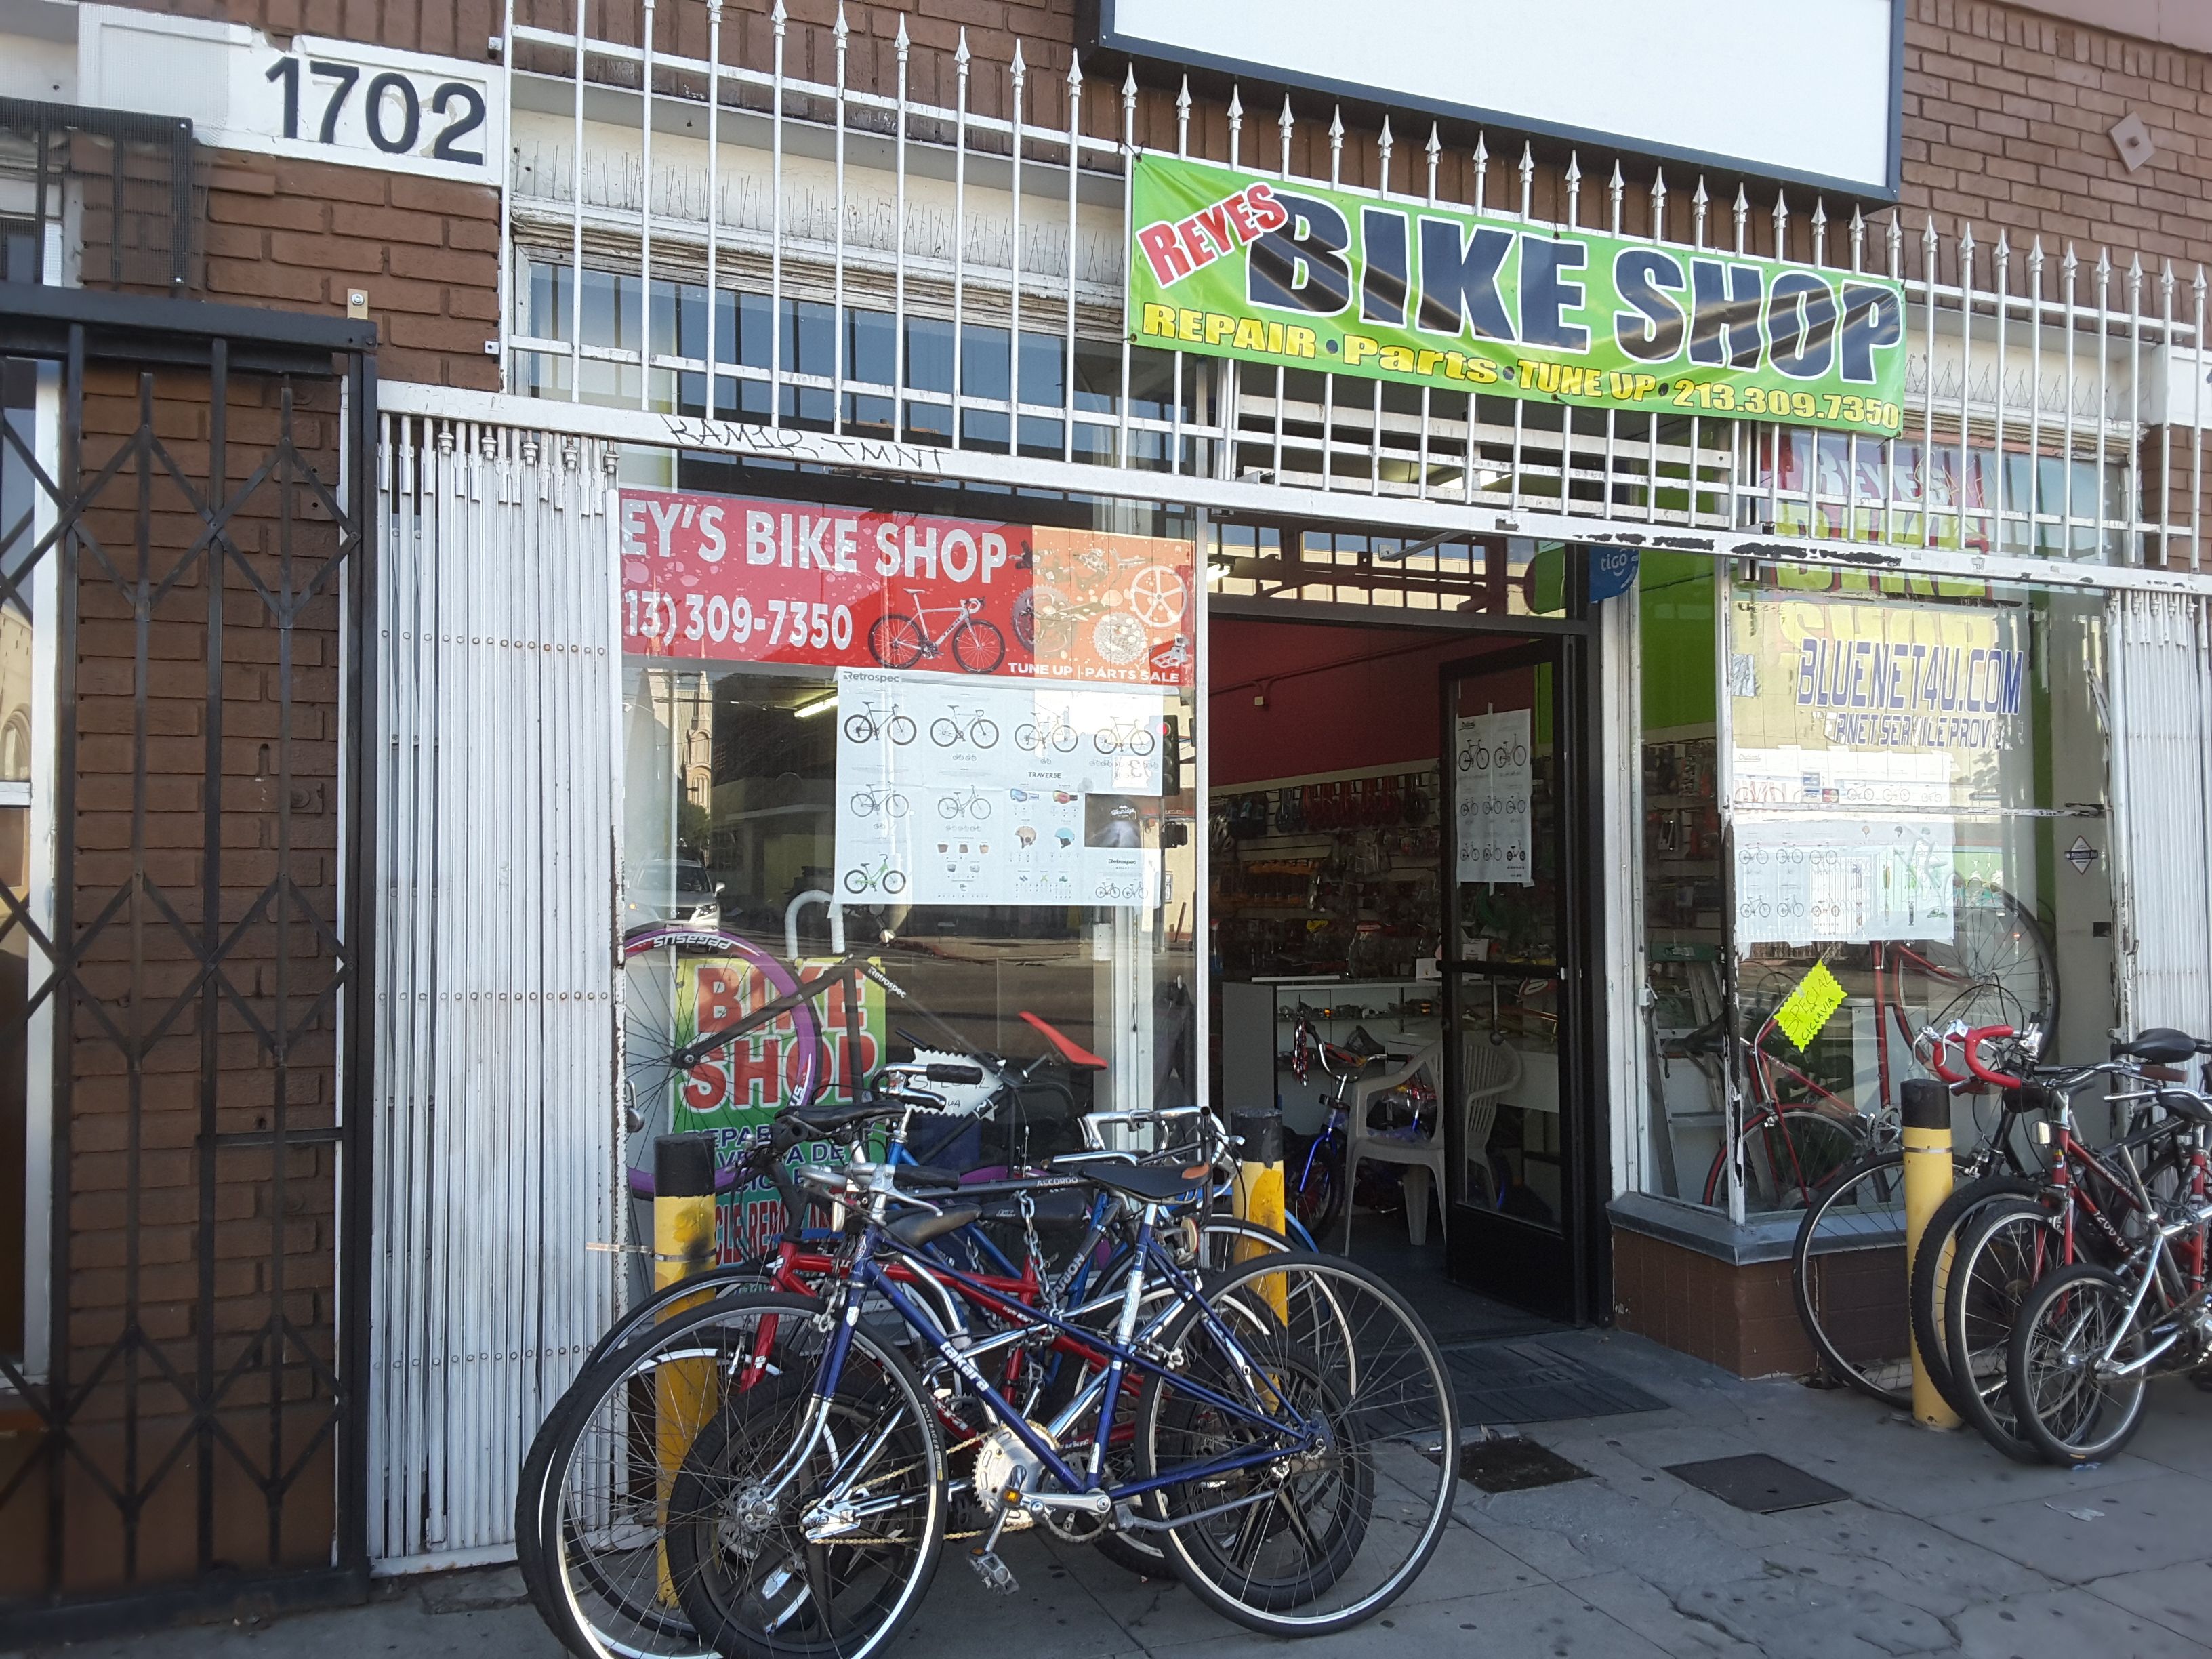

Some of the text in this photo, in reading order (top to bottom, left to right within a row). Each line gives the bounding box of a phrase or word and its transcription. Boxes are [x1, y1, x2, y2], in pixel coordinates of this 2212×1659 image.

[265, 56, 485, 165] 1702
[1136, 182, 1288, 289] REYES
[1246, 189, 1903, 384] BIKE SHOP
[1142, 302, 1900, 430] REPAIR Parts TUNE UP 213.309.7350
[821, 438, 950, 473] TMNT
[621, 498, 1008, 585] EY'S BIKE SHOP
[623, 589, 853, 650] 13) 309-7350
[844, 671, 900, 684] Retrospec
[1008, 662, 1179, 683] TUNE UP PARTS SALE
[1796, 637, 2024, 716] BLUENET4U.COM
[868, 966, 907, 999] Retrospec
[1783, 973, 1832, 1038] SPECIAL
[1036, 1176, 1078, 1187] ACCORDO
[940, 1341, 989, 1391] takara
[920, 1404, 939, 1451] BONTRAGER
